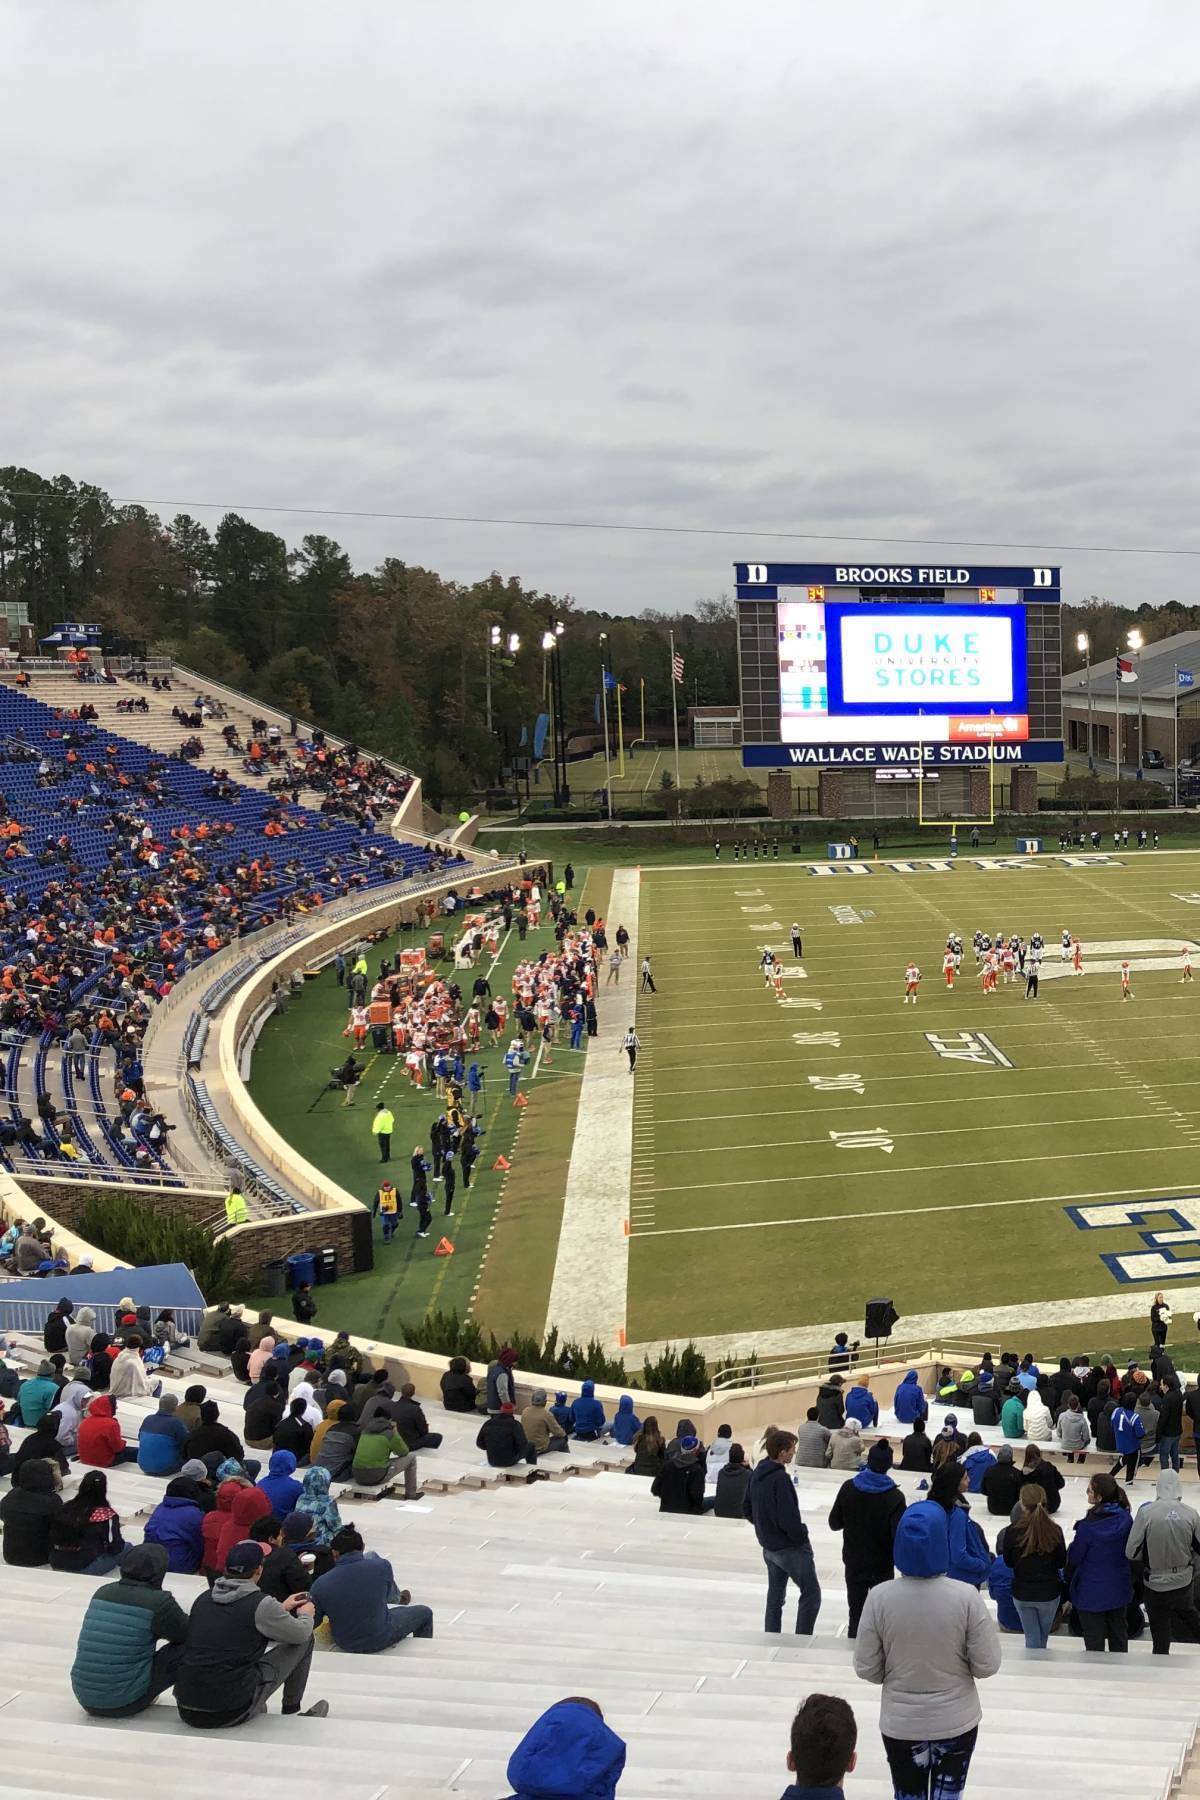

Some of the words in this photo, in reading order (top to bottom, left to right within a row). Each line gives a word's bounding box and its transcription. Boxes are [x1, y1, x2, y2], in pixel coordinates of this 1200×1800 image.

[747, 564, 768, 583] D
[835, 568, 913, 583] BROOKS
[918, 569, 970, 584] FIELD
[1033, 568, 1052, 586] D
[808, 587, 824, 601] 34
[980, 588, 995, 602] 34
[874, 632, 979, 654] DUKE
[874, 657, 979, 665] UNIVERSITY
[875, 668, 981, 687] STORES
[789, 747, 877, 763] WALLACE
[881, 747, 935, 761] WADE
[940, 746, 1022, 760] STADIUM
[802, 855, 1125, 876] DUKE
[791, 1031, 841, 1045] 30
[807, 1073, 865, 1090] 20
[828, 1127, 894, 1149] 10
